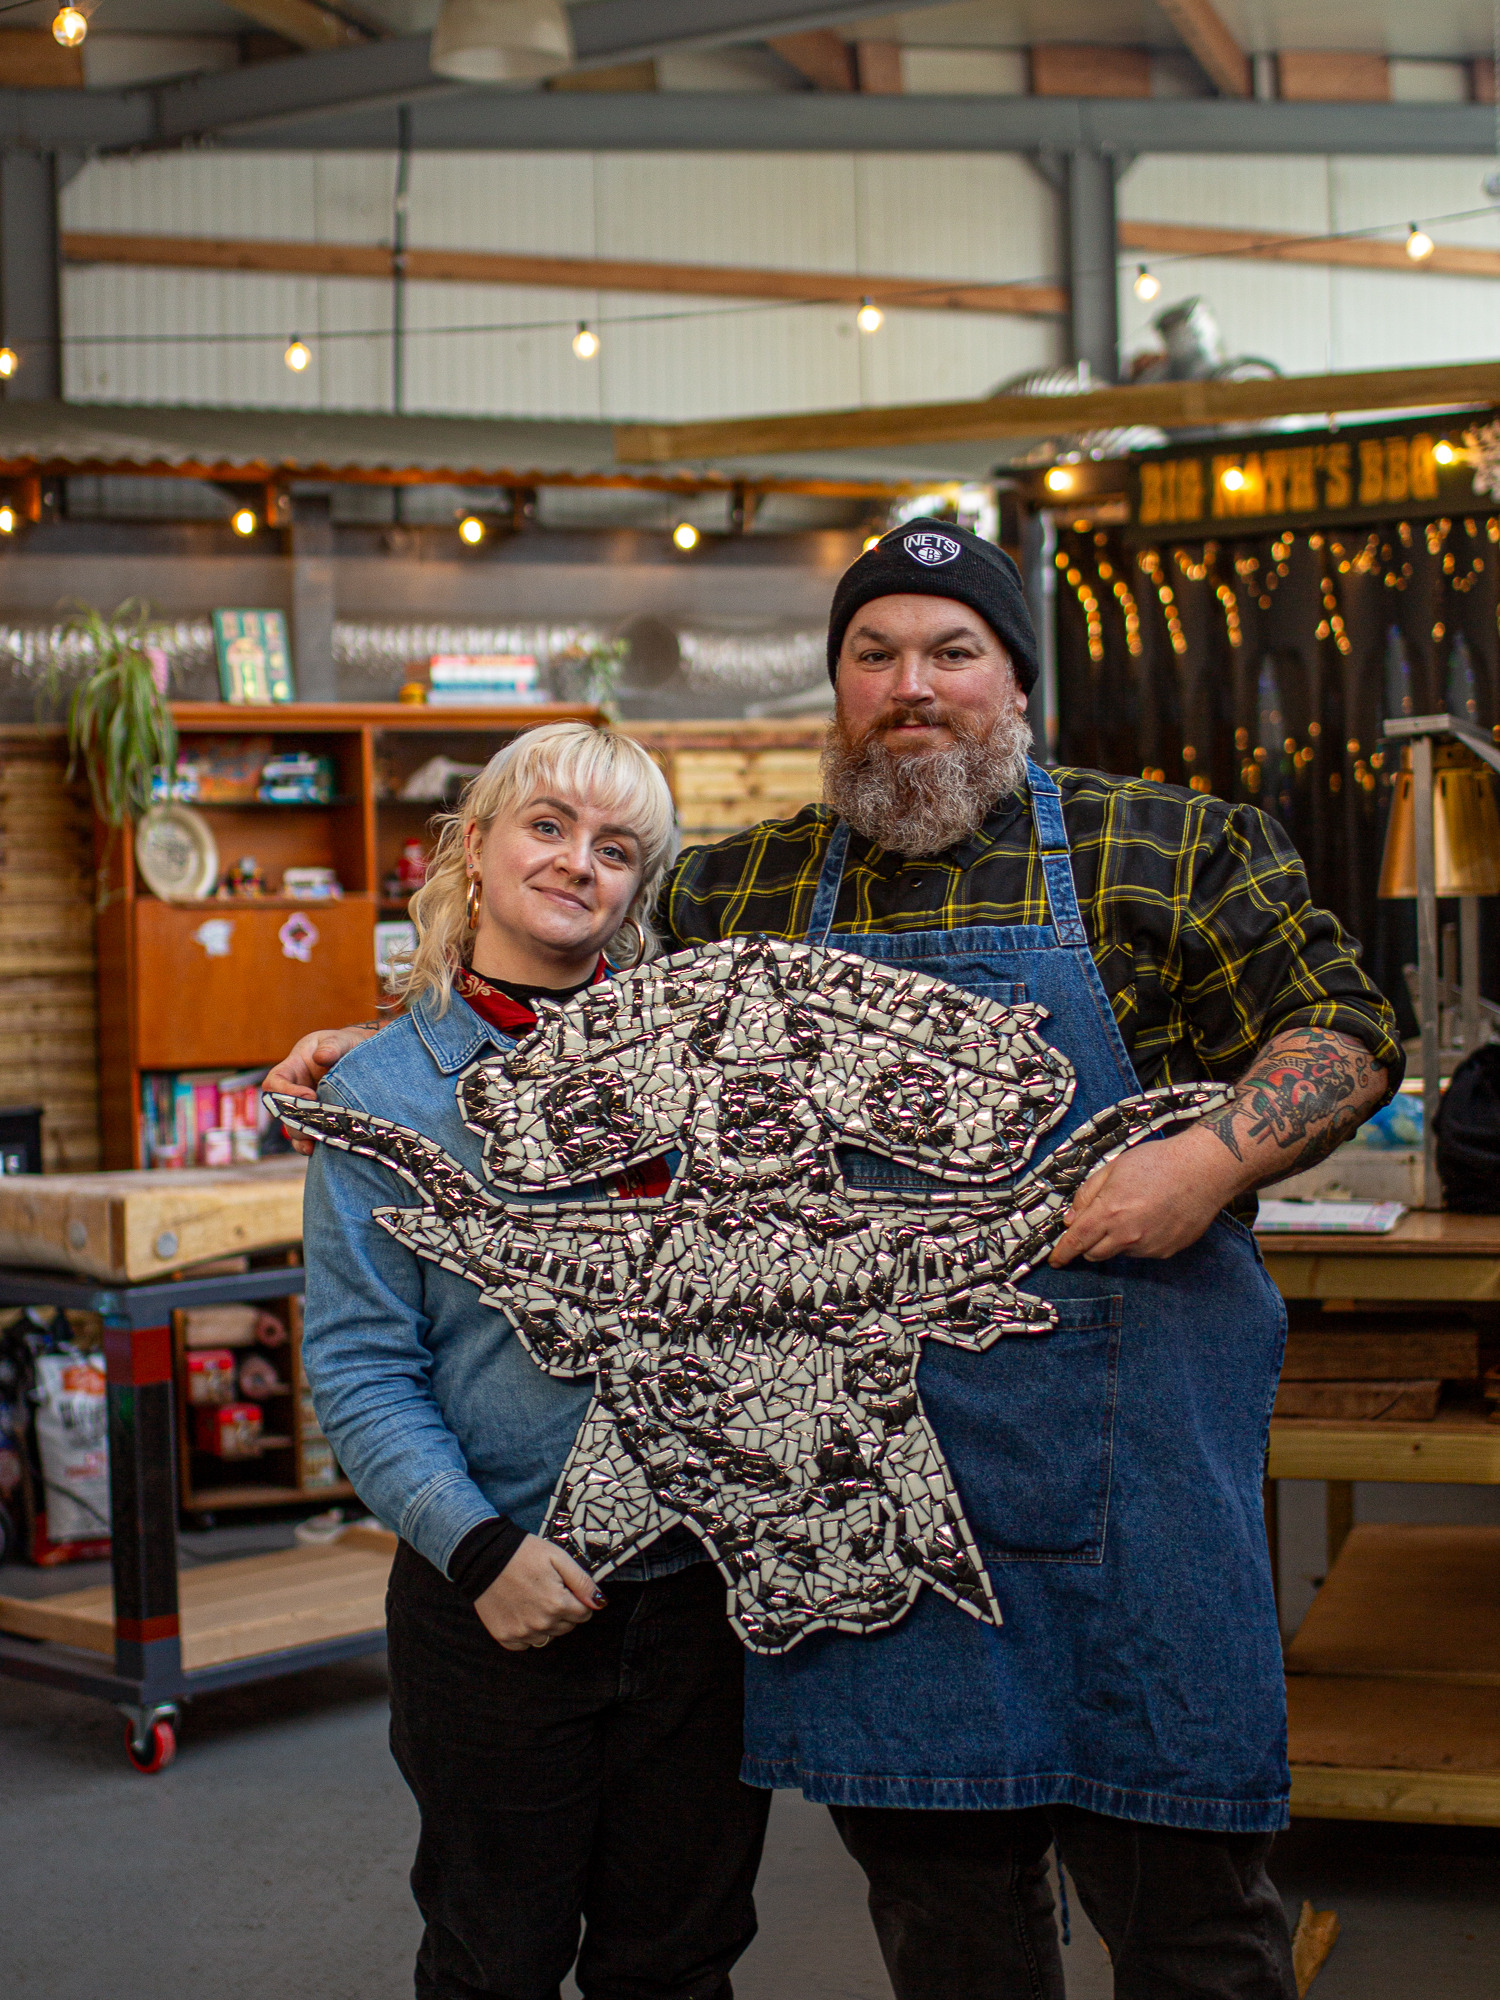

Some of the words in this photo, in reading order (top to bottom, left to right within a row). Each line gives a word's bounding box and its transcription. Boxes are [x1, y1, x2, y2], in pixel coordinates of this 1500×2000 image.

[1140, 458, 1202, 524] BIG
[1358, 432, 1438, 505] BBQ
[907, 535, 956, 554] NETS
